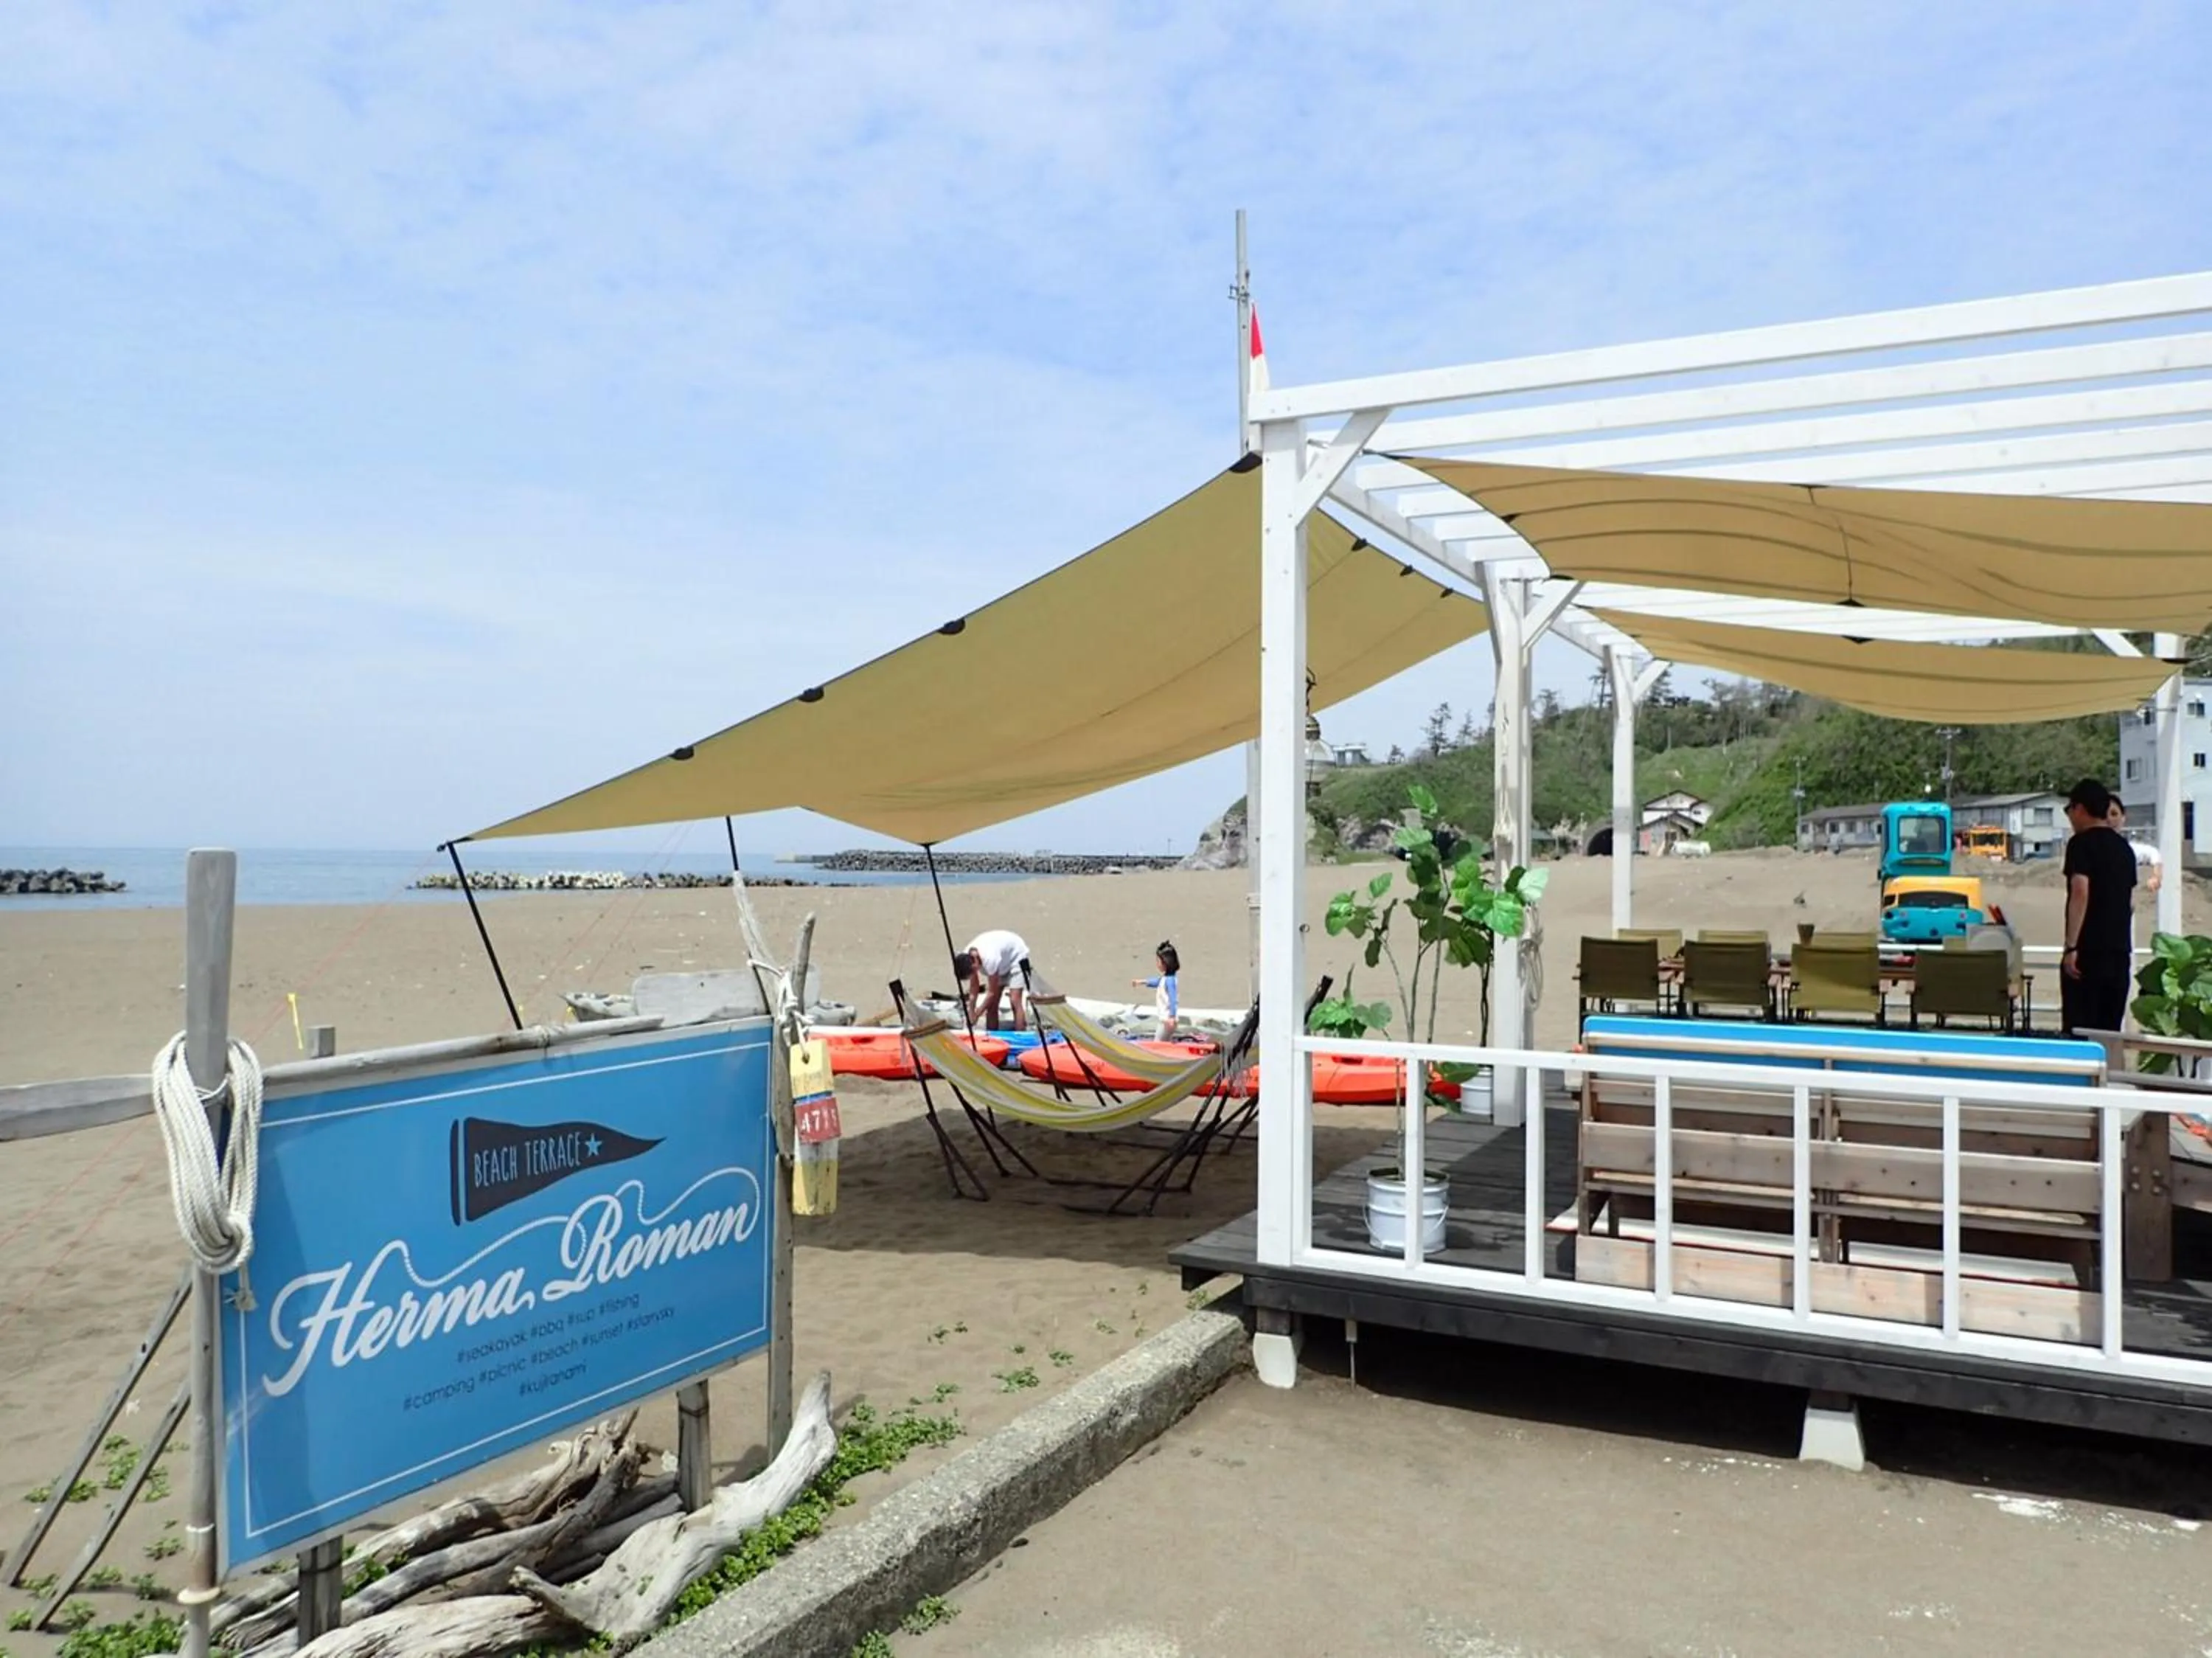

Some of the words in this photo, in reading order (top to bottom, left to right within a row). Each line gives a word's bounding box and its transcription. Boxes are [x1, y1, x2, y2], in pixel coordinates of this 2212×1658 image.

[474, 1145, 518, 1189] BEACH
[524, 1131, 581, 1176] TERRACE
[262, 1239, 535, 1397] Herma
[542, 1193, 759, 1303] Roman
[403, 1376, 476, 1412] #camping
[479, 1357, 527, 1384] #picnic
[531, 1339, 579, 1365] #beach
